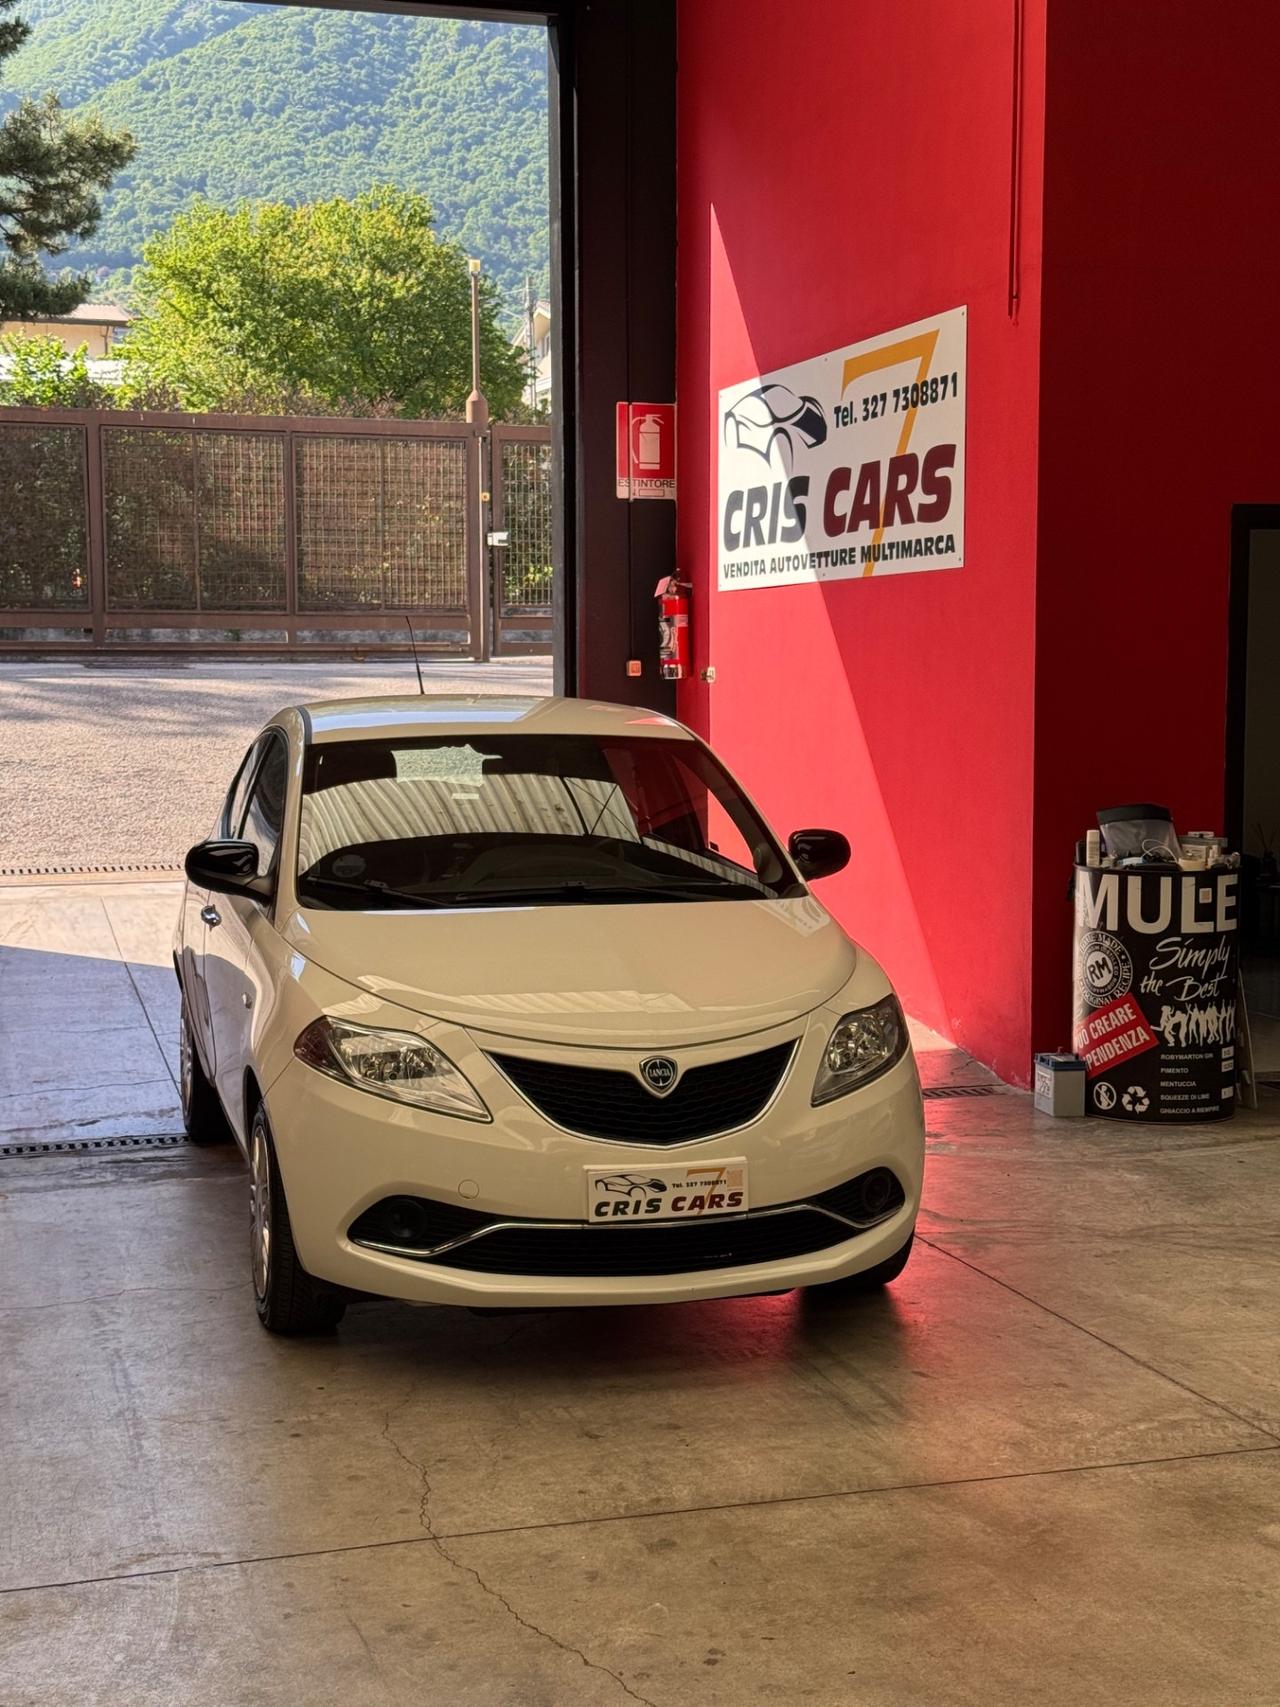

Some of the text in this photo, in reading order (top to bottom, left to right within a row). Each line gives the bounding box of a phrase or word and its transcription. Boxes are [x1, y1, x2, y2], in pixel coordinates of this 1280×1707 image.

[834, 372, 958, 428] Tel. 327 7308871
[618, 479, 675, 488] ESTINTORE
[723, 443, 957, 552] CRIS CARS
[723, 534, 955, 579] VENDITA AUTOVETTURE MULTIMARCA
[1075, 870, 1238, 934] MULE
[1088, 957, 1112, 983] RM
[1149, 935, 1230, 979] Simply
[1140, 971, 1163, 996] the
[1166, 972, 1228, 1001] Best
[1089, 1003, 1137, 1040] CREARE
[649, 1068, 671, 1077] LANCIA
[594, 1192, 743, 1217] CRIS CARS
